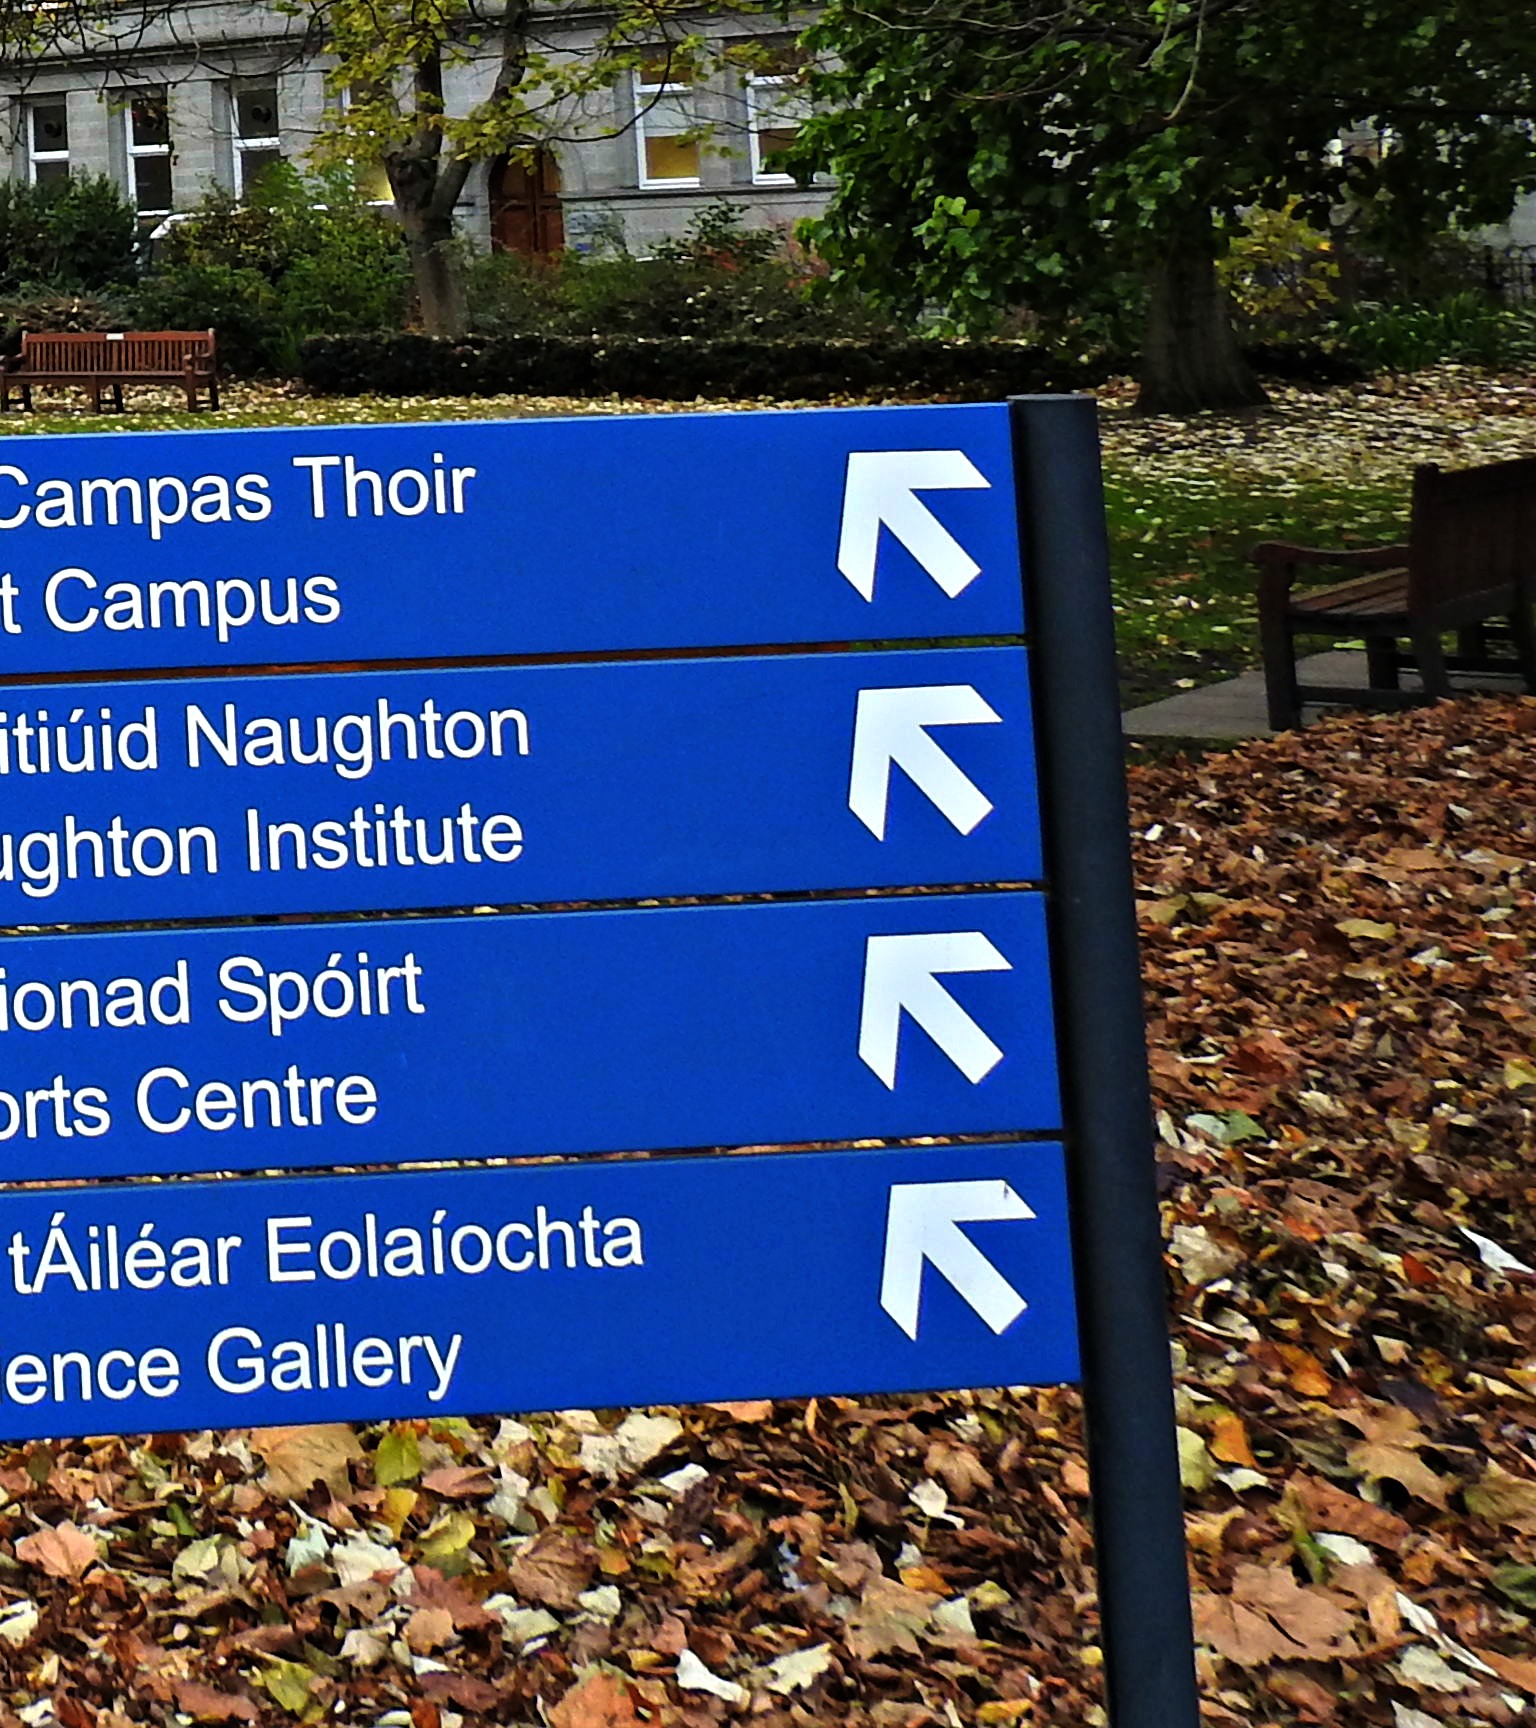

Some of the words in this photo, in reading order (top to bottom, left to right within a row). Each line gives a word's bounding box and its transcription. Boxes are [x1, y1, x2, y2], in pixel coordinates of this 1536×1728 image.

[291, 451, 478, 519] Thoir
[44, 567, 342, 644] Campus
[185, 697, 530, 780] Naughton
[246, 801, 524, 873] Institute
[217, 951, 427, 1038] Spóirt
[135, 1063, 379, 1135] Centre
[6, 1210, 243, 1296] tÁiléar
[266, 1204, 645, 1283] Eolaíochta
[206, 1321, 463, 1402] Gallery
